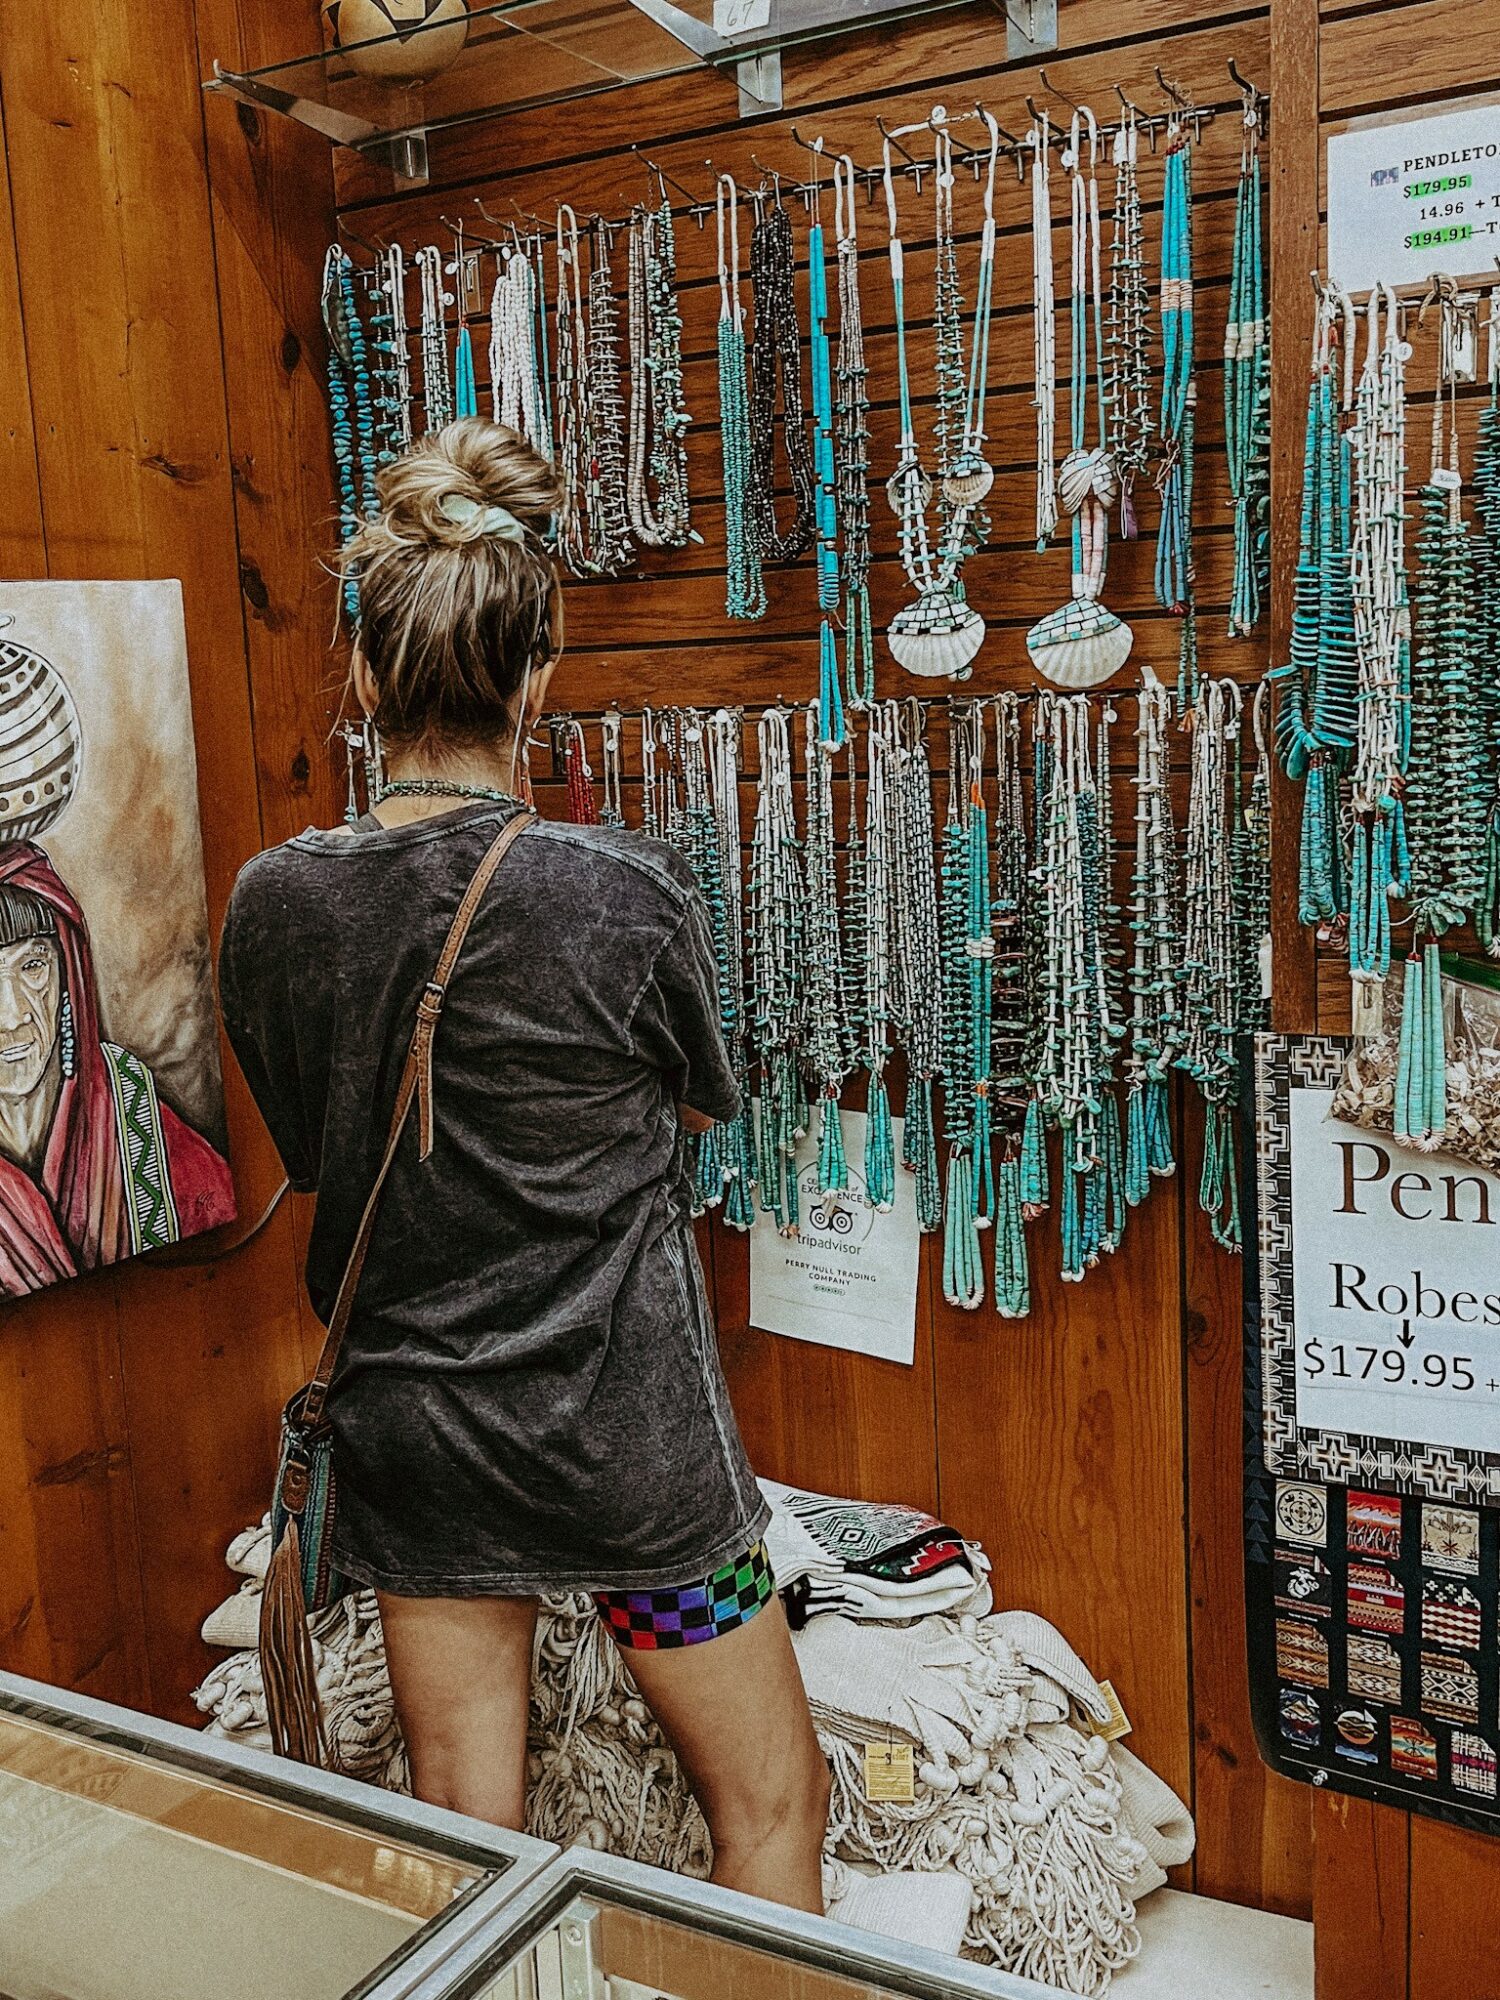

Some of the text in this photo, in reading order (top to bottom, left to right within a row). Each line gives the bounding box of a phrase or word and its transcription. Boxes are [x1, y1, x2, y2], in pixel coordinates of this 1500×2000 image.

[1404, 143, 1500, 172] PENDLETO
[1403, 175, 1468, 198] $179.95
[1420, 202, 1464, 220] 14.96
[802, 1184, 863, 1203] EXCENCE
[1331, 1141, 1496, 1224] Pen
[797, 1233, 862, 1255] tripadvisor
[785, 1259, 876, 1282] PERRY NULL TRADING
[808, 1272, 851, 1286] COMPANY
[1329, 1262, 1500, 1325] Robes
[1303, 1336, 1475, 1391] $179.95
